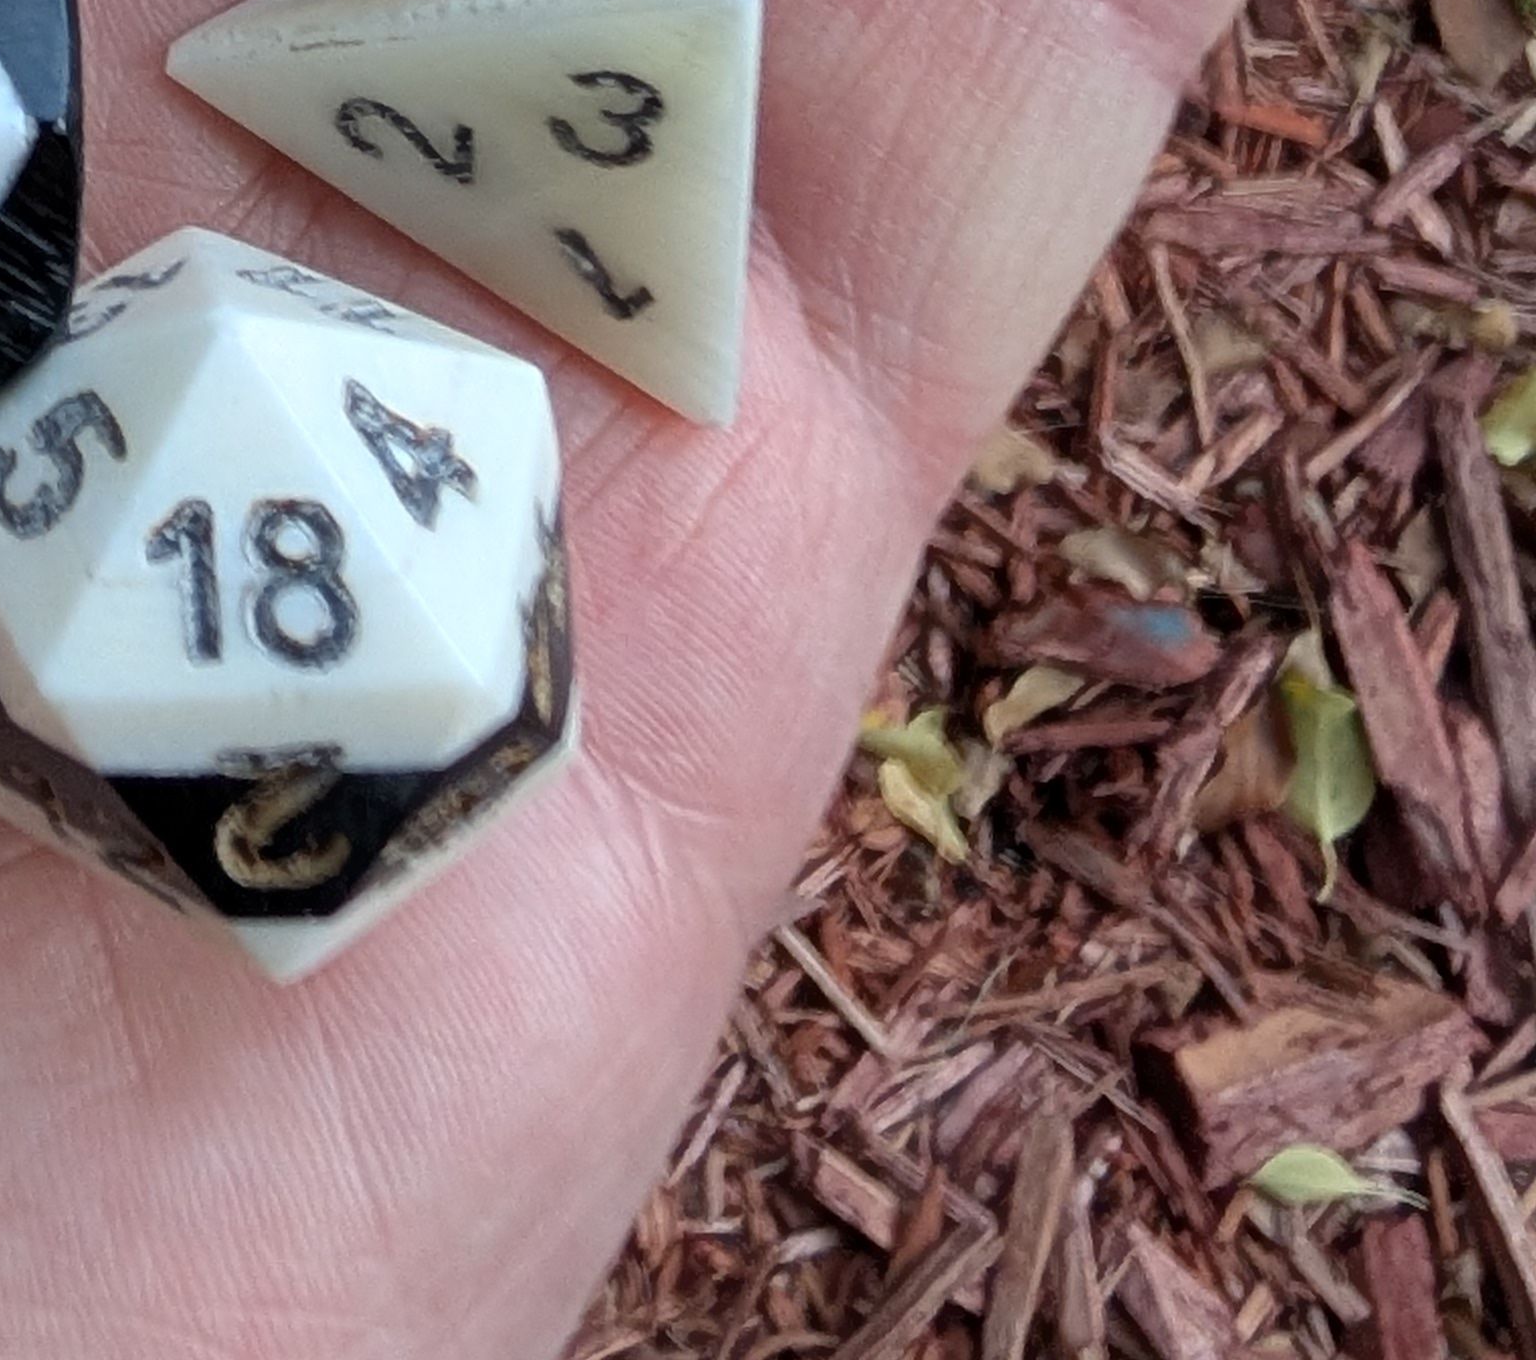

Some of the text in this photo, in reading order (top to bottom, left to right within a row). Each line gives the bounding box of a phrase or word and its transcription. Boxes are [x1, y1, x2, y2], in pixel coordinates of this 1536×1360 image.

[335, 96, 476, 185] 2
[543, 69, 667, 170] 3
[554, 227, 656, 322] 1
[343, 378, 479, 531] 4
[142, 497, 361, 671] 18
[212, 740, 352, 890] 2
